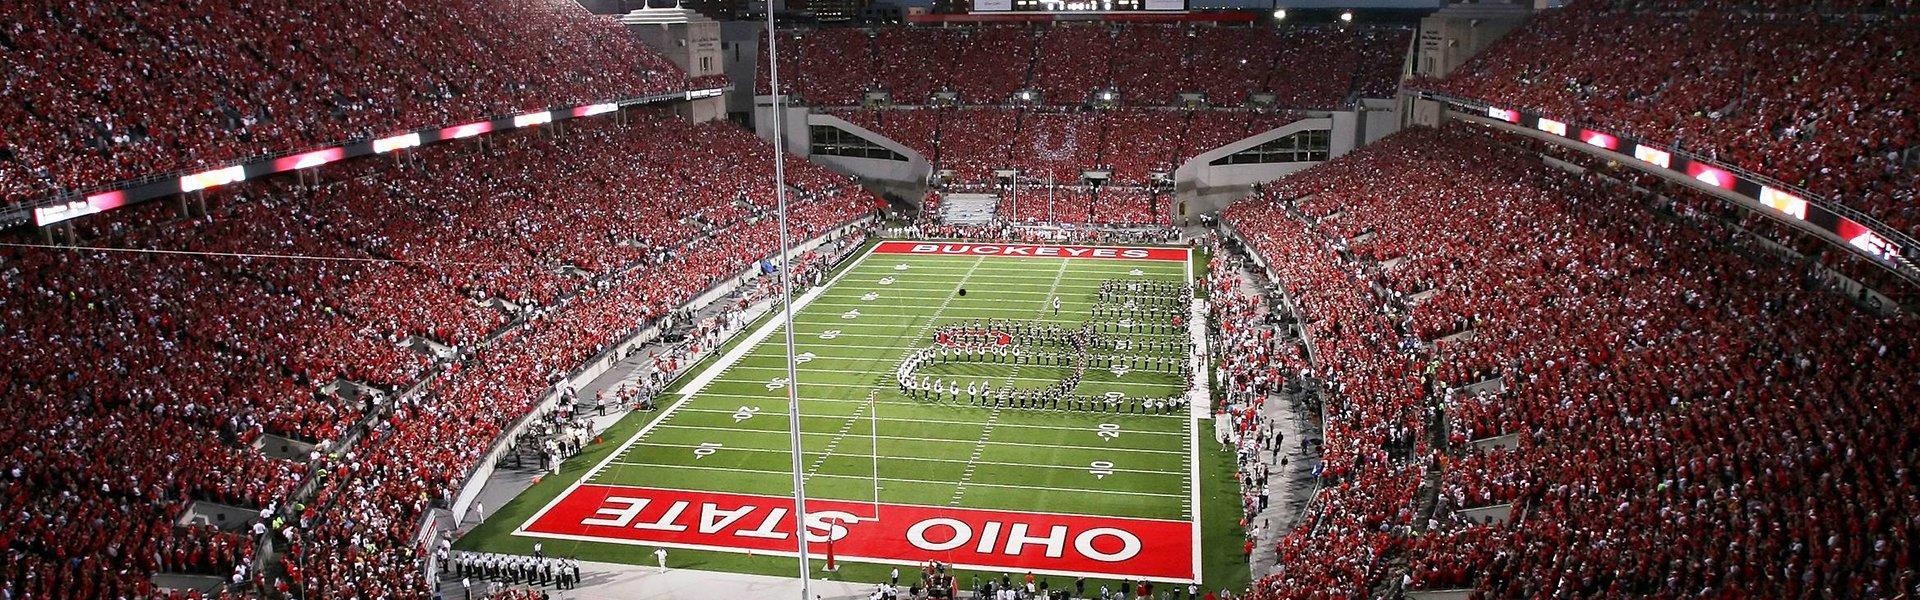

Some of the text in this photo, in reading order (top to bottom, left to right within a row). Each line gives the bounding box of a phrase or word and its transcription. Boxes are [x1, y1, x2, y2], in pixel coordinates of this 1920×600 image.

[911, 243, 1149, 258] BUCKEYES
[765, 377, 789, 389] 30
[732, 405, 760, 419] 20
[1097, 423, 1120, 438] 20
[693, 442, 723, 456] 10
[1089, 461, 1114, 475] 10
[580, 496, 1142, 562] OHIO STATE
